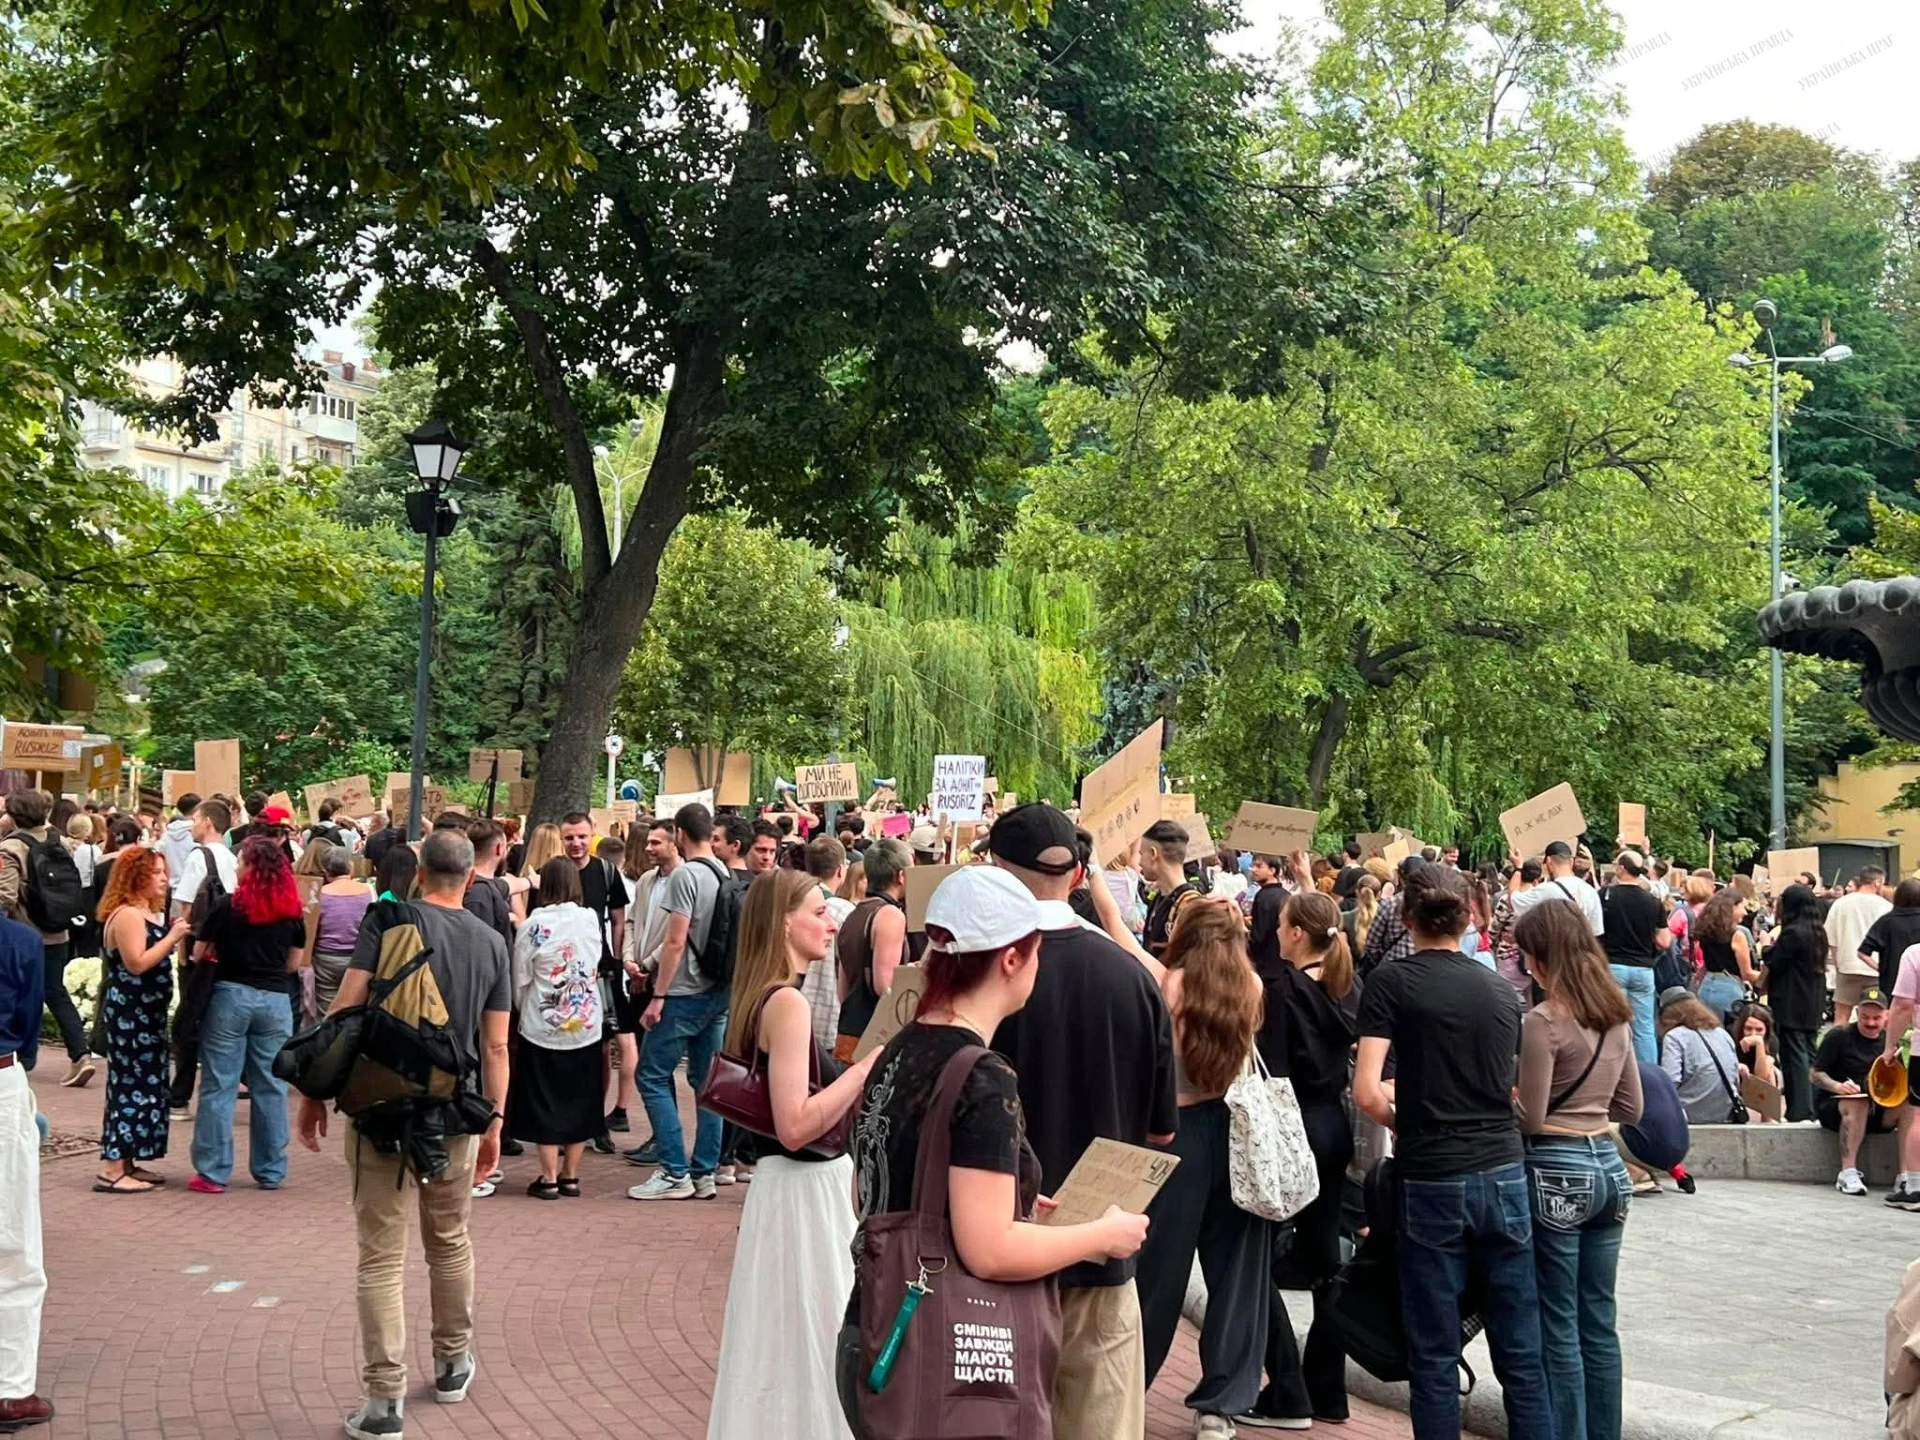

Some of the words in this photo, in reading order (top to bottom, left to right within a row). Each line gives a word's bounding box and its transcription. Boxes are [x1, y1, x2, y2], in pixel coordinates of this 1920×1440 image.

[805, 767, 826, 781] МИ
[828, 765, 843, 780] НЕ
[938, 759, 984, 776] НАЛІПКИ
[799, 780, 852, 799] ДОГОВОРИЛИ!
[935, 778, 947, 792] ЗА
[937, 794, 976, 810] RUSORIZ
[953, 1323, 1013, 1340] СМІЛИВІ
[954, 1336, 1014, 1353] ЗАВЖДИ
[955, 1350, 1014, 1368] МАЮТЬ
[954, 1366, 1015, 1384] ЩАСТЯ
